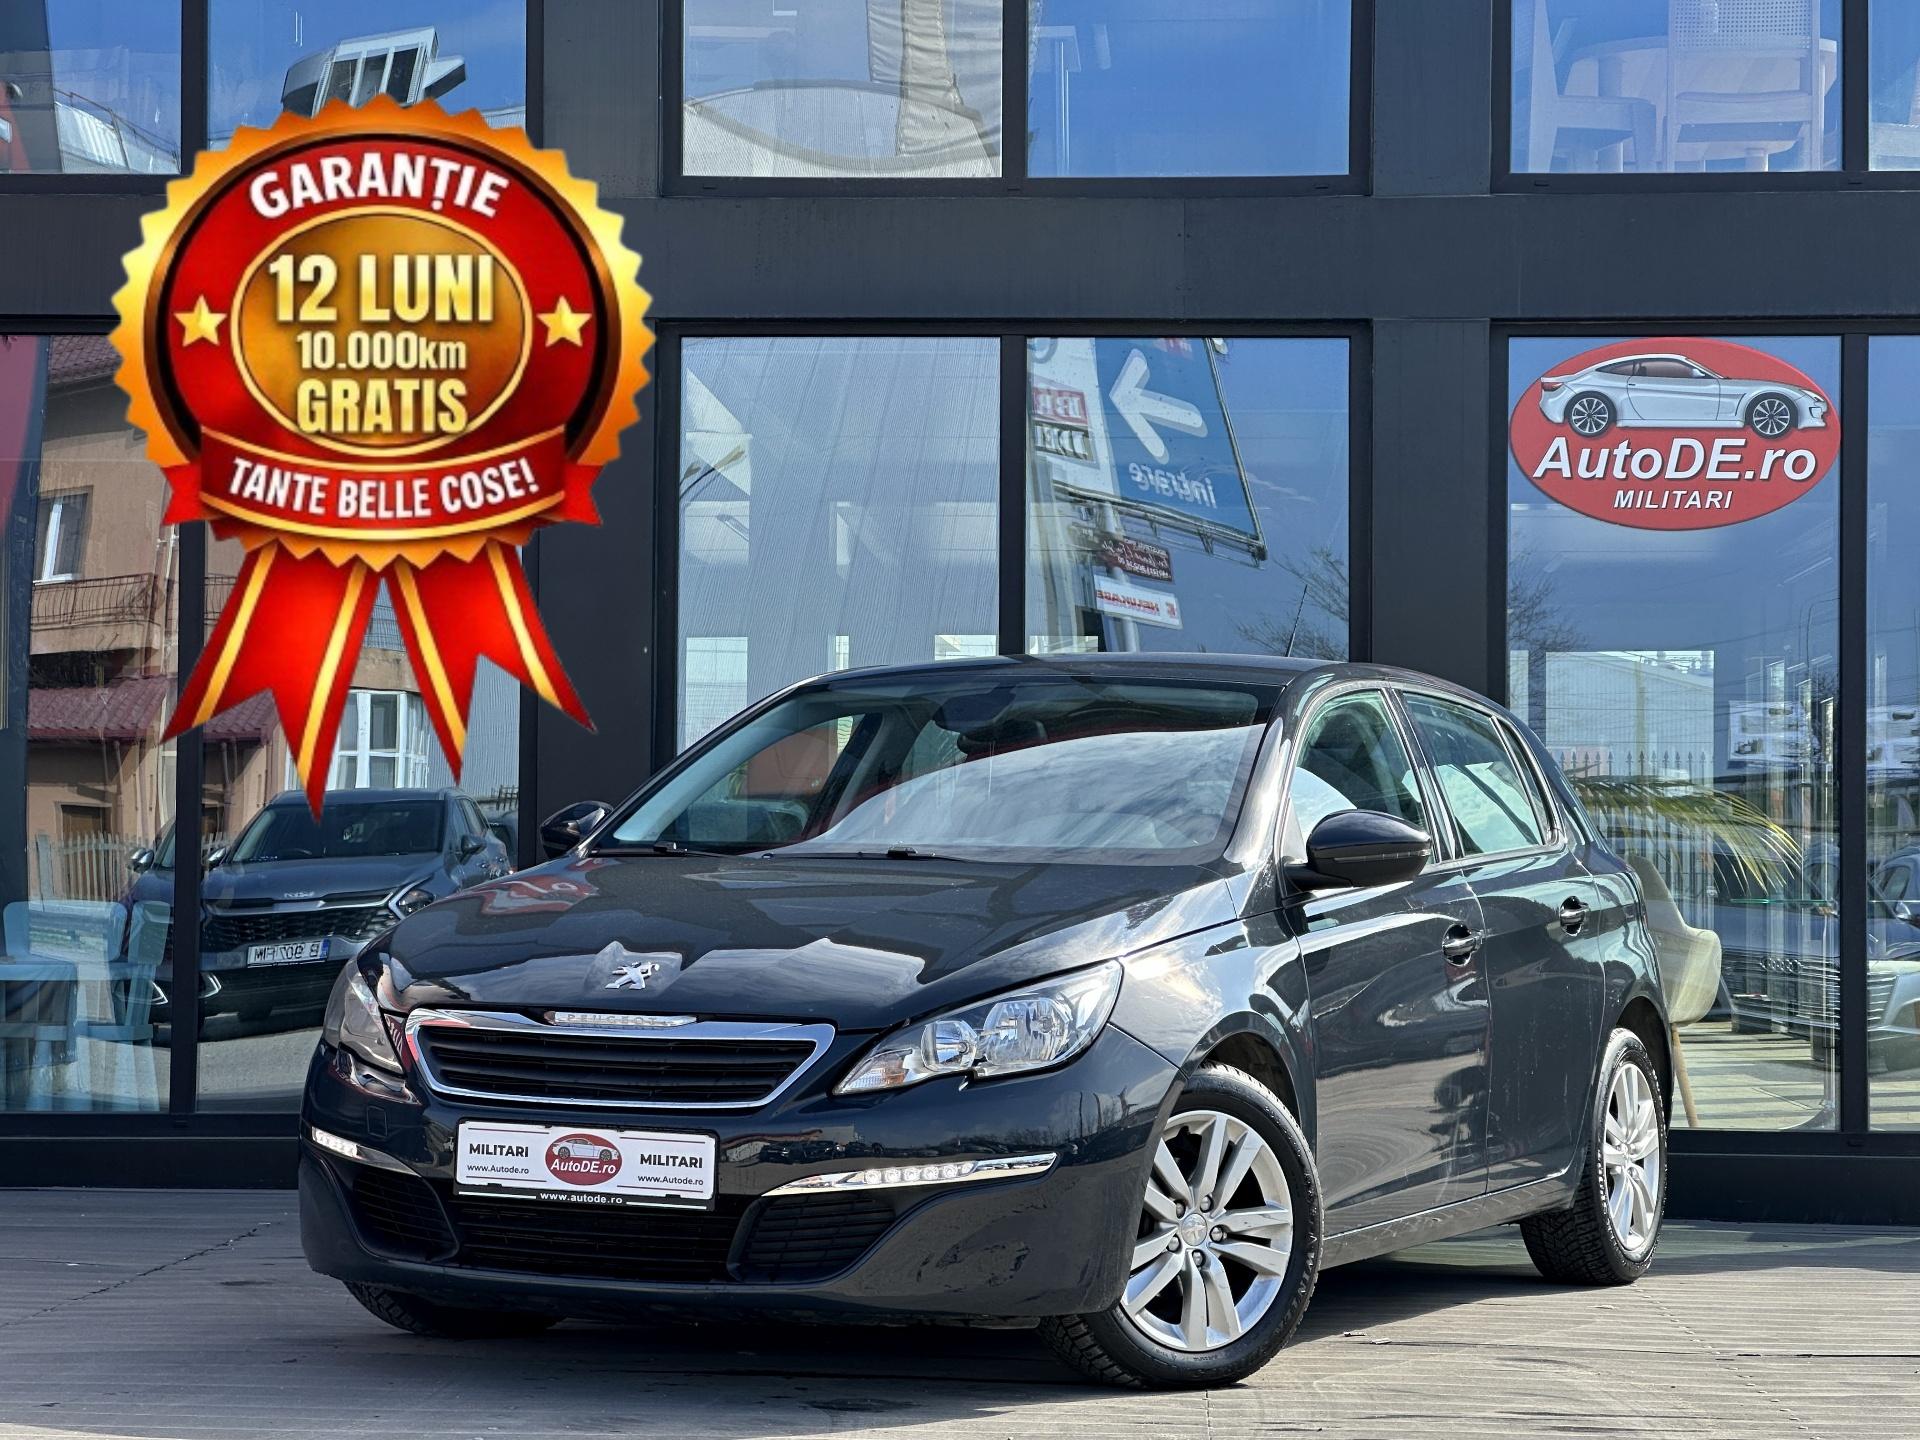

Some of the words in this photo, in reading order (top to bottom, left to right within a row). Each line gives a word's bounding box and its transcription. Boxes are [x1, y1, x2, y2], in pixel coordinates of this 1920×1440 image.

[1533, 436, 1817, 480] AutoDE.ro
[1613, 490, 1733, 510] MILITARI
[567, 1013, 657, 1026] PEUGEOT
[469, 1143, 529, 1158] MILITARI
[550, 1159, 617, 1175] AutoDE.ro
[640, 1153, 703, 1168] MILITARI
[467, 1163, 530, 1175] www.Autode.ro
[638, 1174, 704, 1186] www.Autode.ro
[539, 1192, 623, 1204] www.autode.ro
